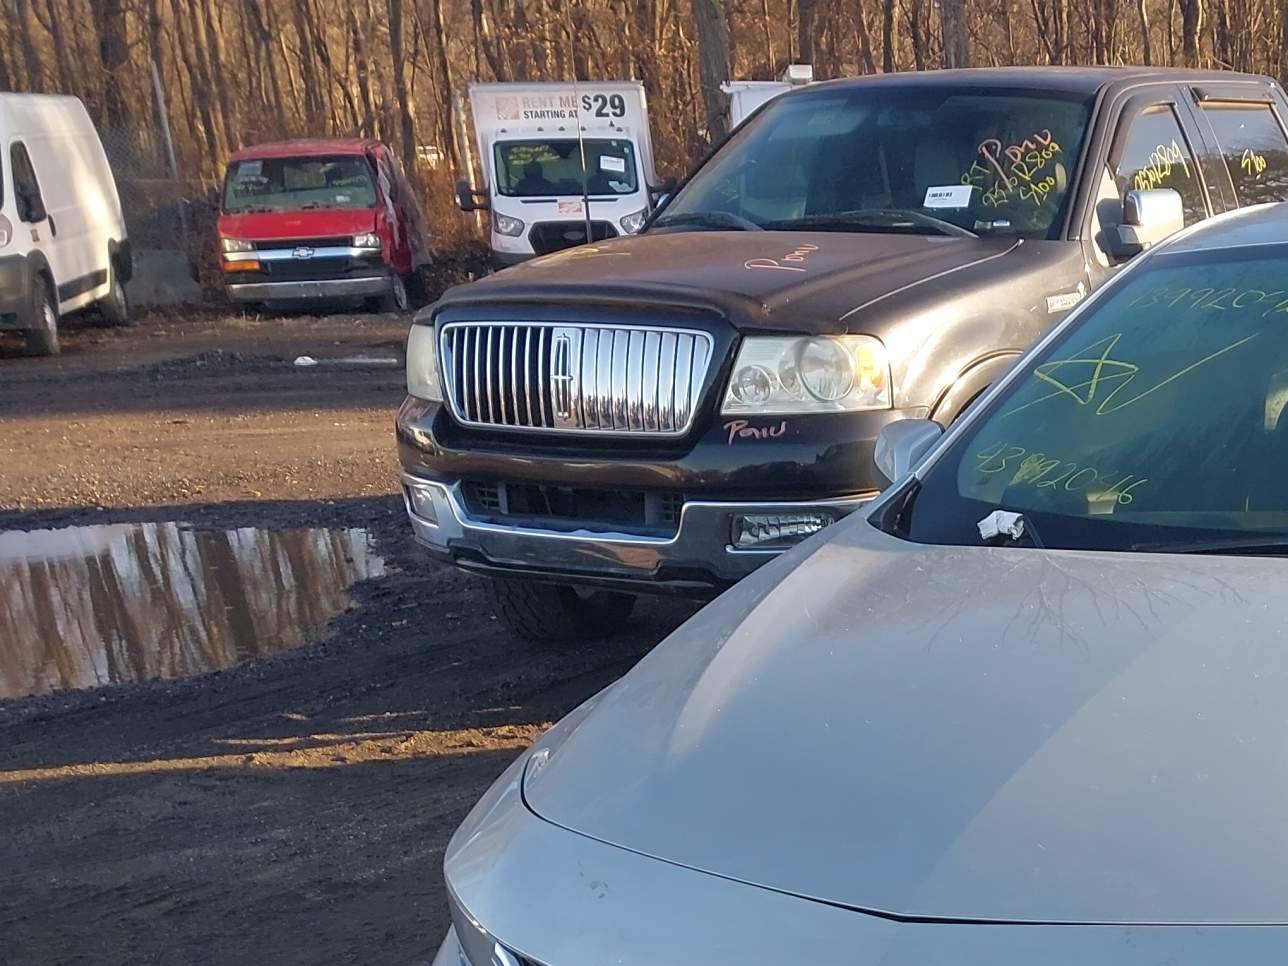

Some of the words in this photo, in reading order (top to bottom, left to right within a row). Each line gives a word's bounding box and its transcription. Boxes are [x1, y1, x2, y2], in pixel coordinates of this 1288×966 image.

[523, 109, 566, 119] STARTING
[568, 110, 579, 119] AT
[582, 93, 626, 118] $29
